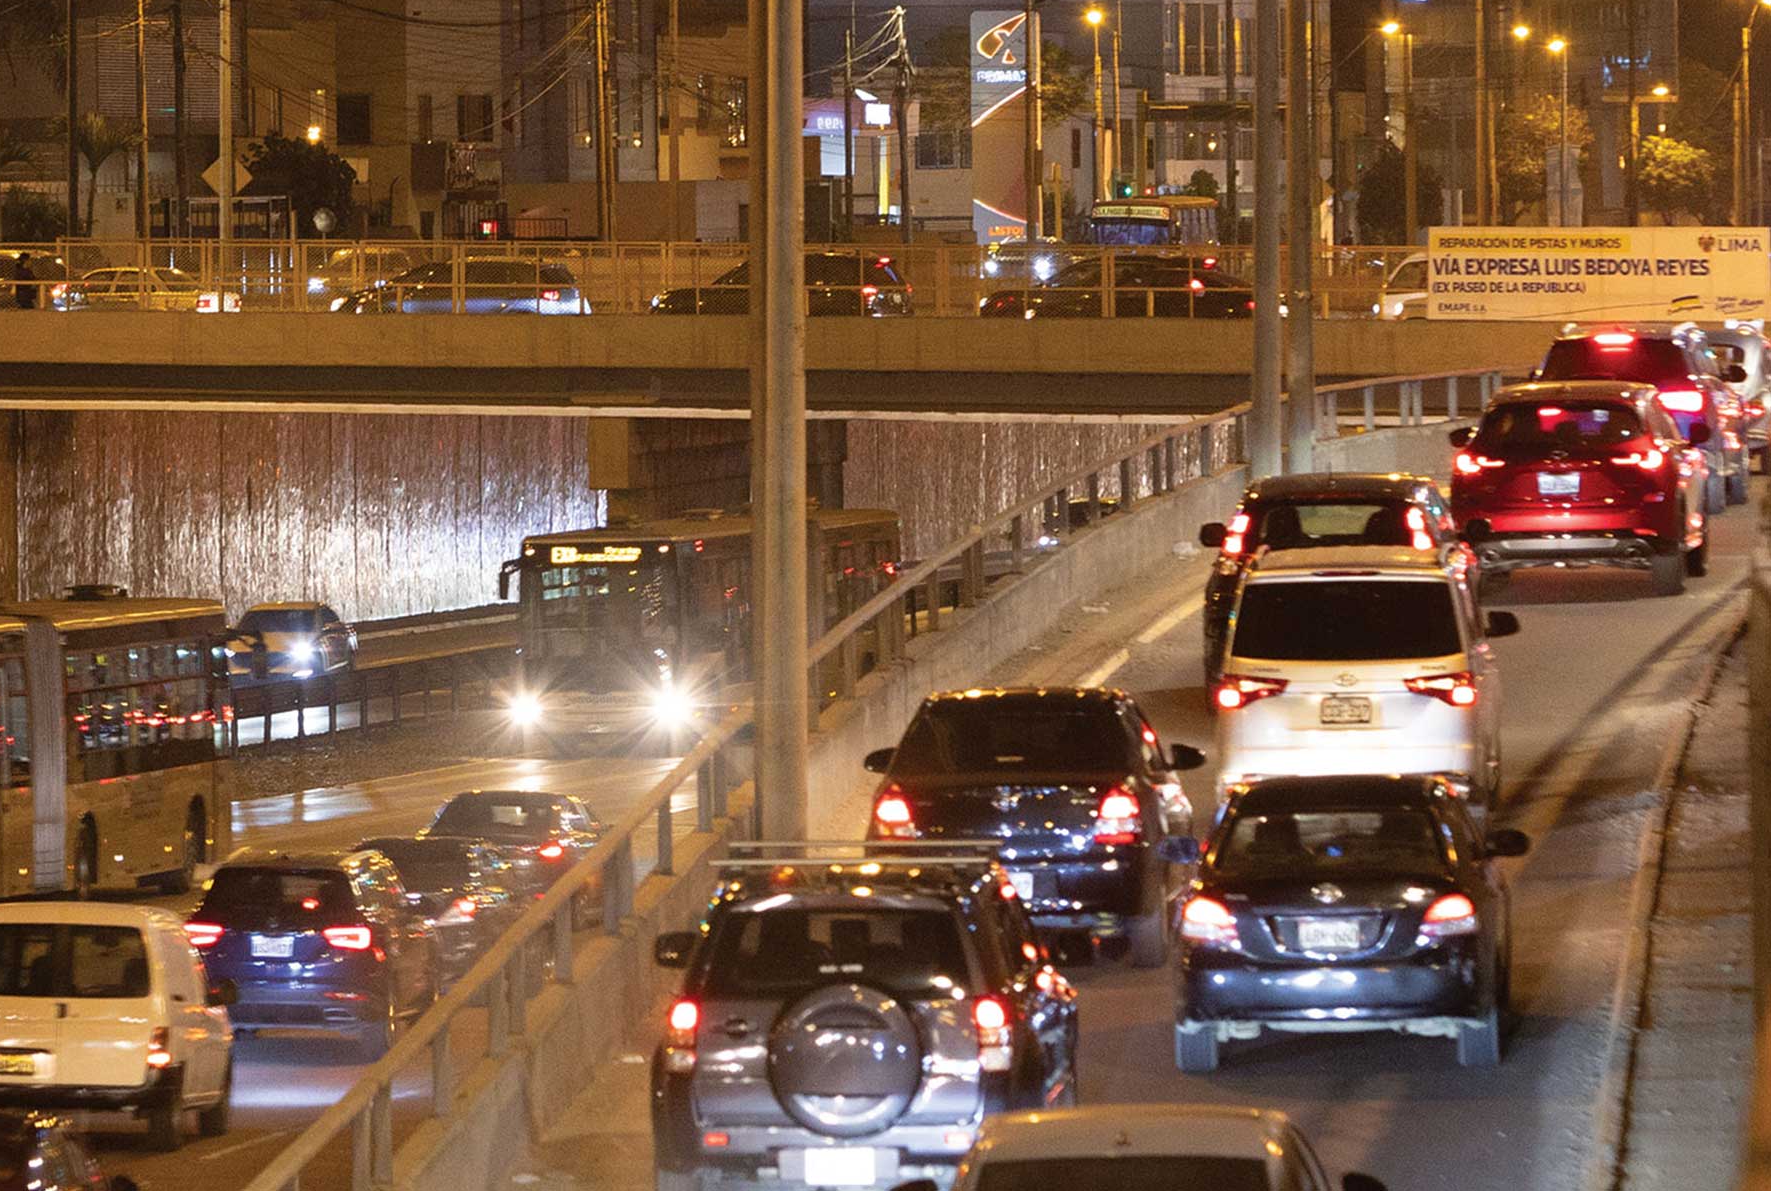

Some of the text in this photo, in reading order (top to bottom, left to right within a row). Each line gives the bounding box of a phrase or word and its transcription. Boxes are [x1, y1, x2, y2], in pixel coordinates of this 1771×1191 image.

[1512, 238, 1526, 249] DE
[1529, 238, 1567, 249] PISTAS
[1570, 238, 1578, 248] Y
[1580, 238, 1622, 249] MUROS
[1718, 238, 1763, 252] LIMA
[1433, 253, 1711, 276] VÍA EXPRESA LUIS BEDOYA REYES
[1432, 281, 1450, 294] (EX
[1453, 282, 1488, 294] PASEO
[1490, 282, 1504, 294] DE
[1506, 282, 1520, 294] LA
[1438, 302, 1471, 313] EMAPE
